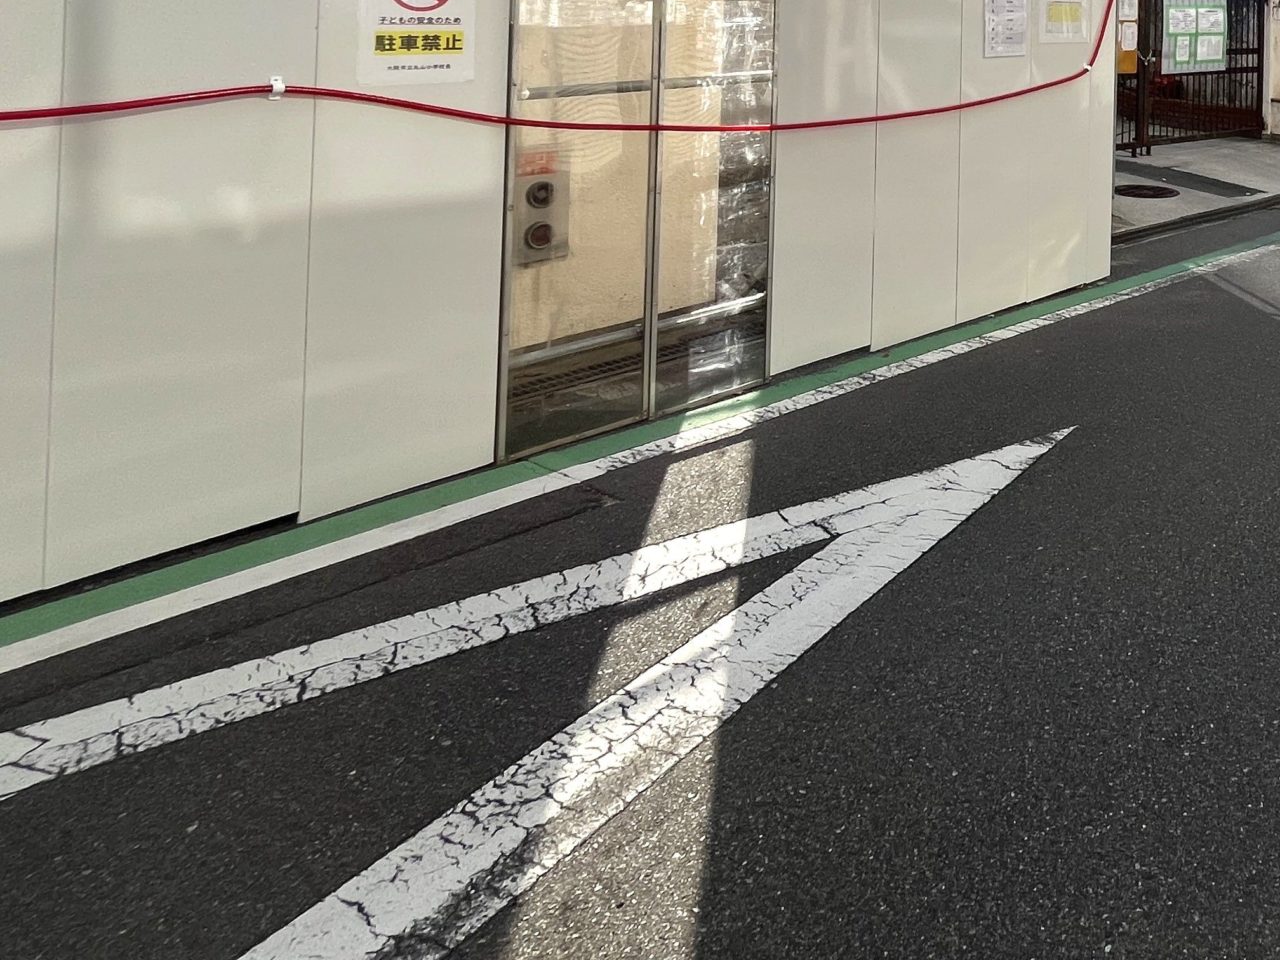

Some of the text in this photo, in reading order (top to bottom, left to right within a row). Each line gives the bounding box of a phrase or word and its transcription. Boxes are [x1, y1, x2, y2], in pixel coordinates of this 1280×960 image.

[379, 16, 462, 25] 子どもの安全のため
[374, 34, 463, 52] 駐車禁止
